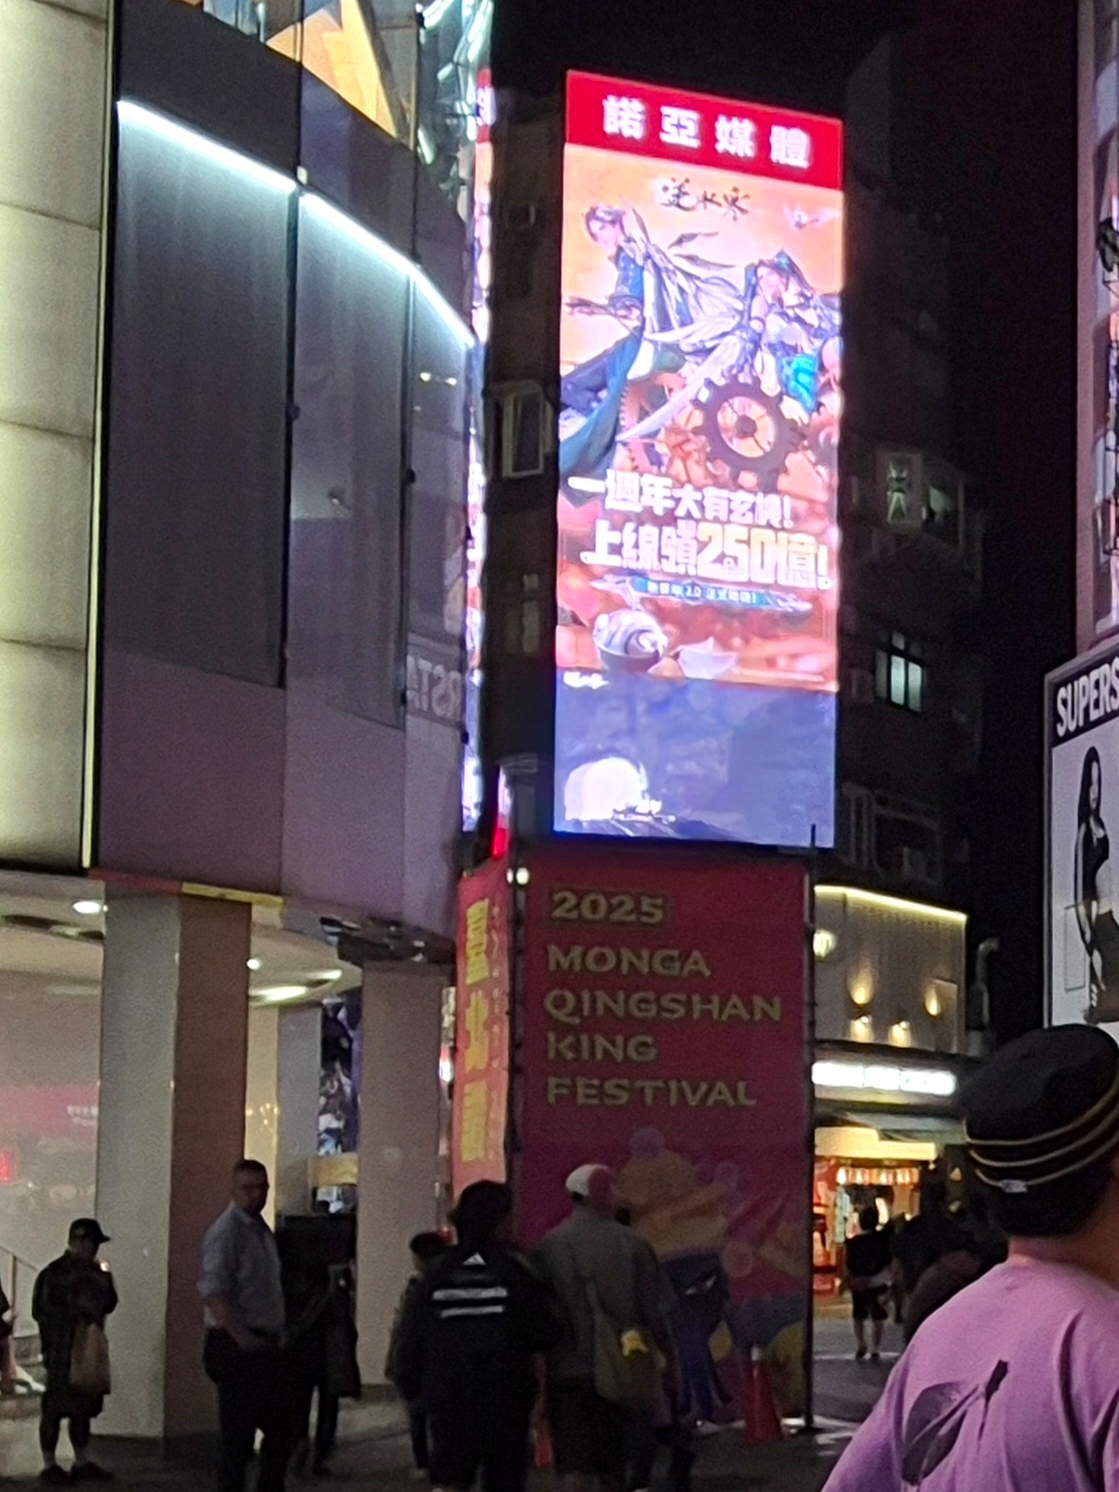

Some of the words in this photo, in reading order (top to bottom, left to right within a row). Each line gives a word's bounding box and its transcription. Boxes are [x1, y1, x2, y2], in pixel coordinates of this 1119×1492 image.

[602, 94, 811, 170] 諾亞媒體
[552, 891, 665, 924] 2025
[547, 944, 711, 978] MONGA
[544, 989, 782, 1024] QINGSHAN
[547, 1033, 658, 1062] KING
[547, 1077, 757, 1107] FESTIVAL
